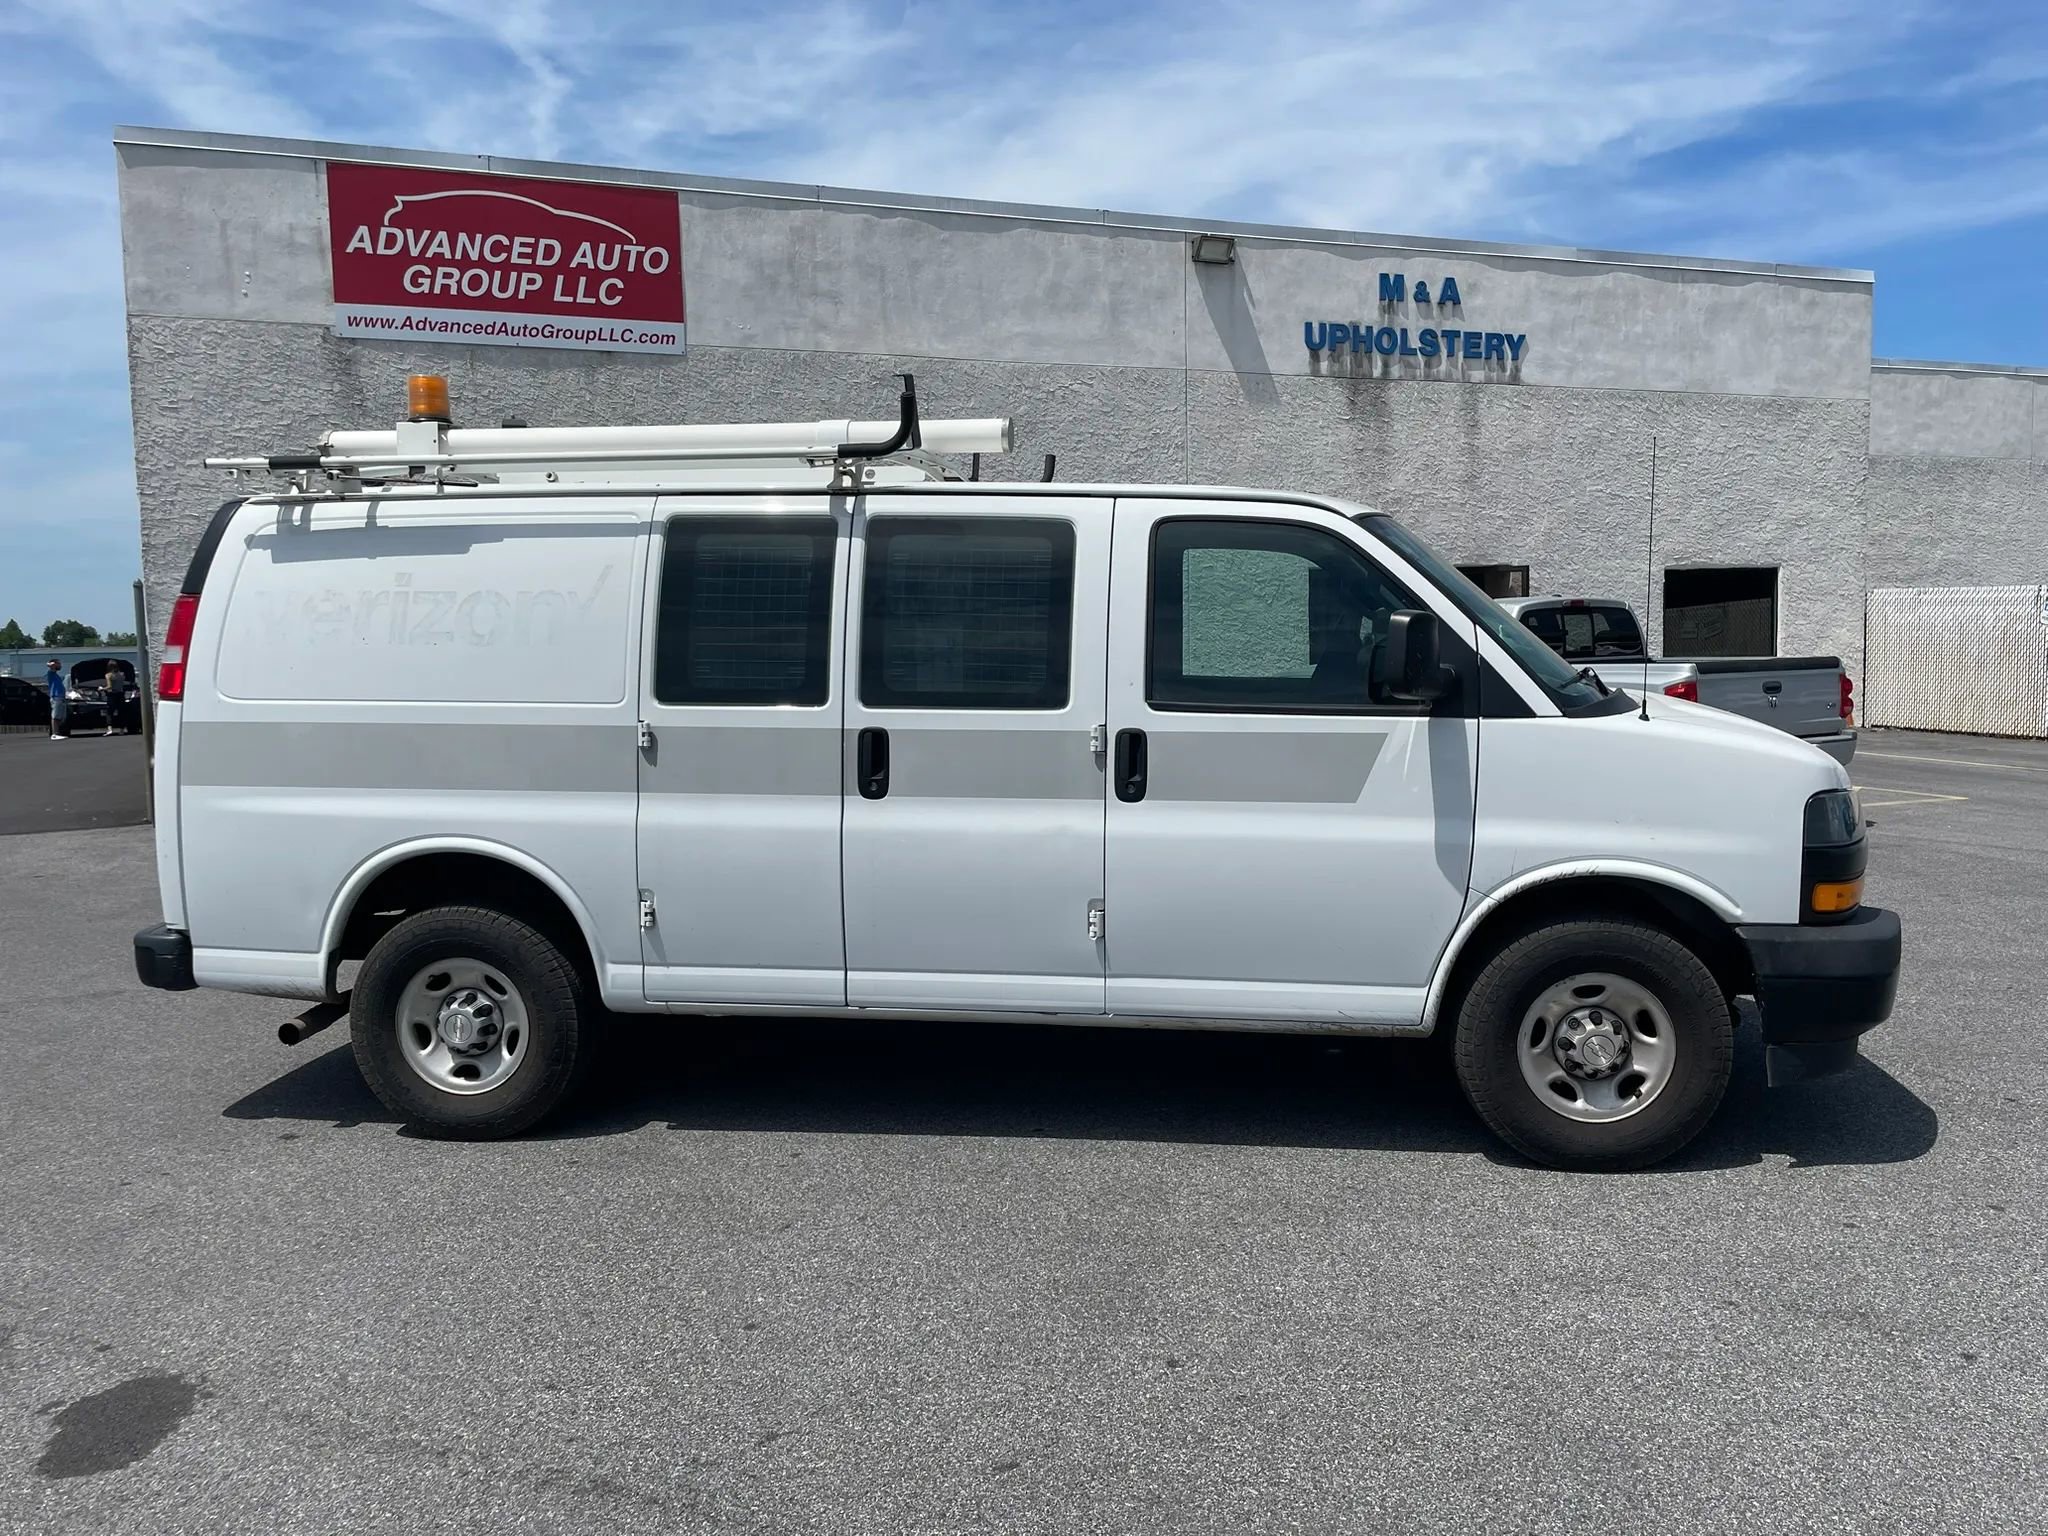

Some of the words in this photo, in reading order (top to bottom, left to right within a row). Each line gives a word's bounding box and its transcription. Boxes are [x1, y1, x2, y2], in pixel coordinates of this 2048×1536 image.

[345, 225, 562, 266] ADVANCED
[569, 241, 670, 275] AUTO
[403, 264, 543, 300] GROUP
[553, 274, 625, 306] LLC
[1378, 272, 1405, 303] M
[1413, 280, 1431, 304] &
[1437, 277, 1462, 306] A
[346, 315, 677, 346] www.AdvancedAutoGroupLLC.com
[1304, 321, 1527, 361] UPHOLSTERY
